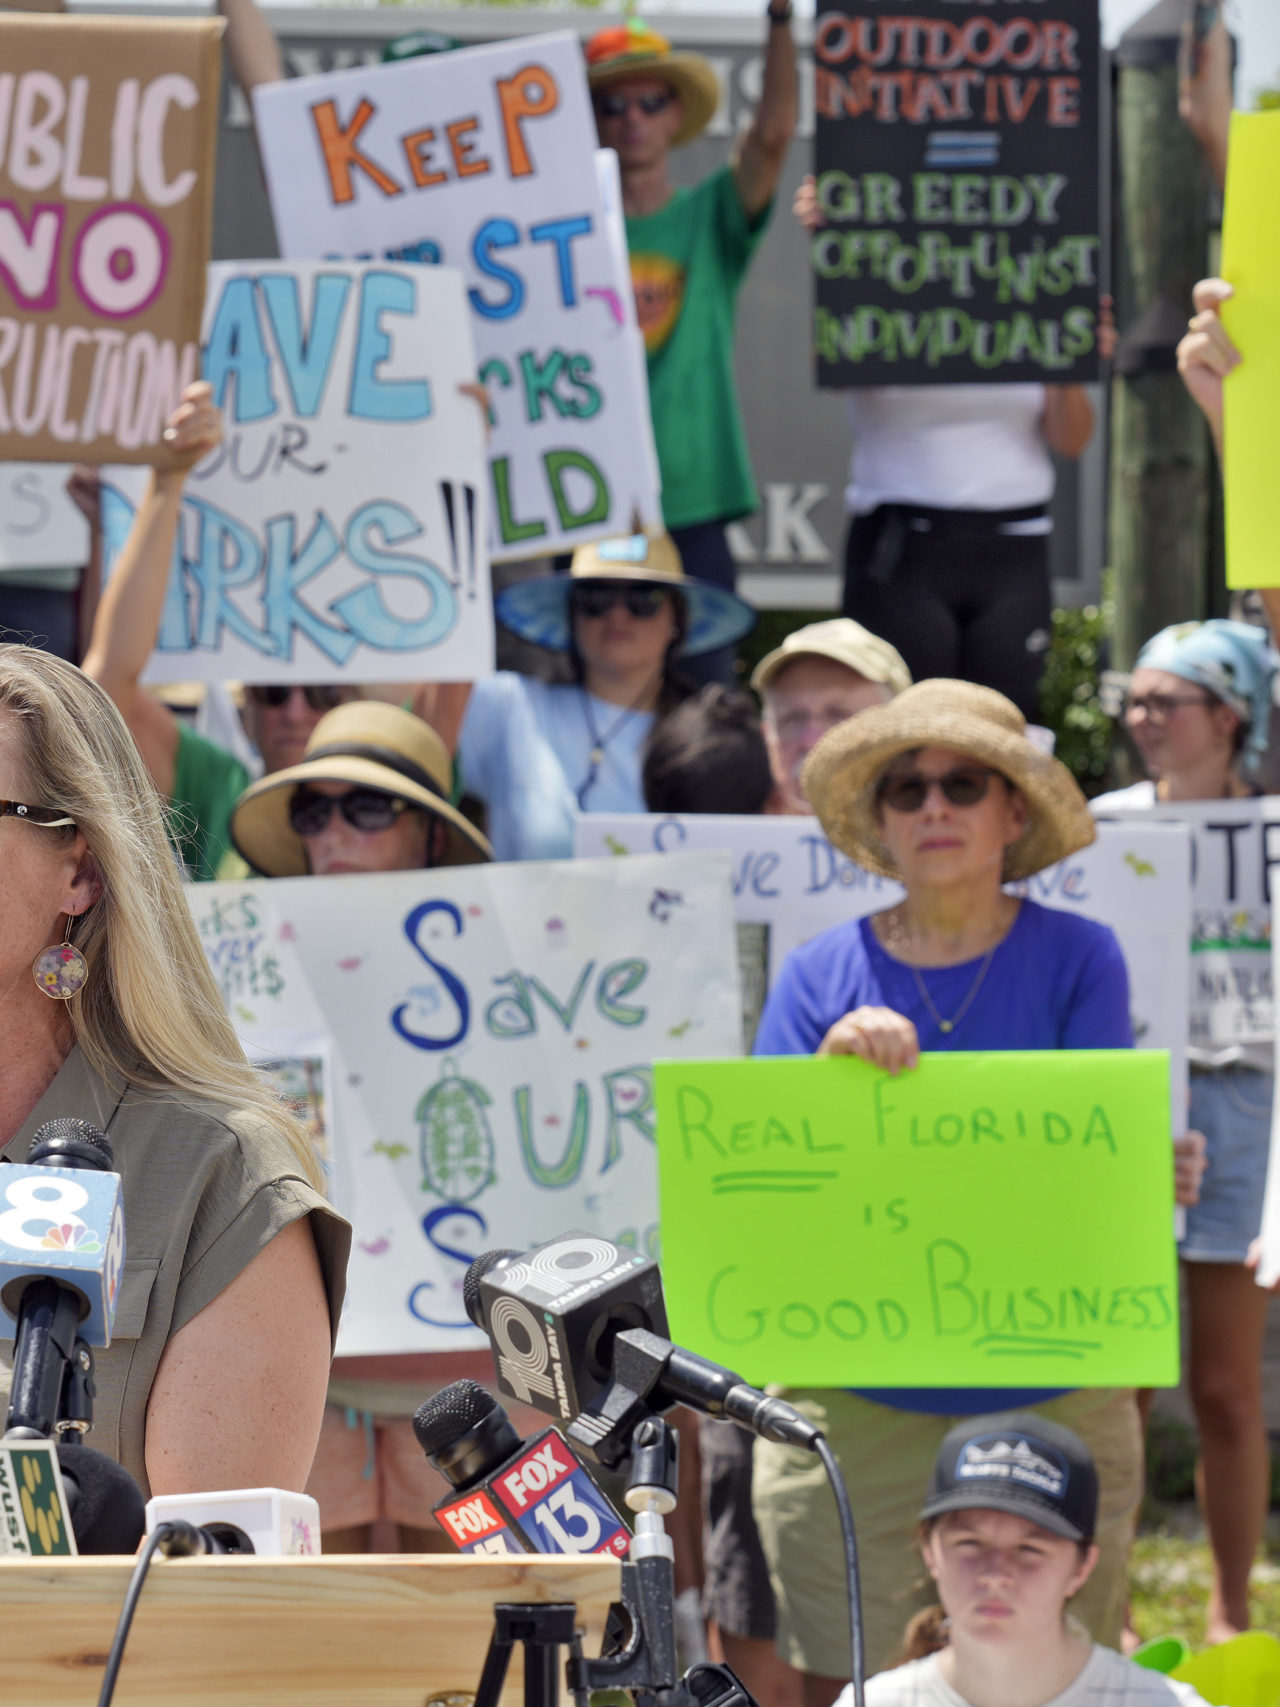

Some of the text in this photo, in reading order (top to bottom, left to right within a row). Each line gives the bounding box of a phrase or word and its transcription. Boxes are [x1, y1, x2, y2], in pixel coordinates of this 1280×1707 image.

[814, 11, 1080, 70] OUTDOOR
[310, 64, 559, 205] KEEP
[818, 170, 1068, 226] GREEDY
[468, 215, 593, 320] ST
[201, 270, 432, 424] AVE
[492, 450, 611, 545] LD
[390, 899, 651, 1051] Save
[676, 1074, 1118, 1160] REAL FLORIDA
[863, 1199, 910, 1233] IS
[547, 1262, 634, 1309] TAMPA BAY
[707, 1238, 1175, 1346] GOOD BUSINESS
[546, 1323, 571, 1419] TAMPA BAY
[444, 1496, 498, 1540] FOX
[503, 1442, 568, 1508] FOX
[534, 1480, 601, 1554] 13
